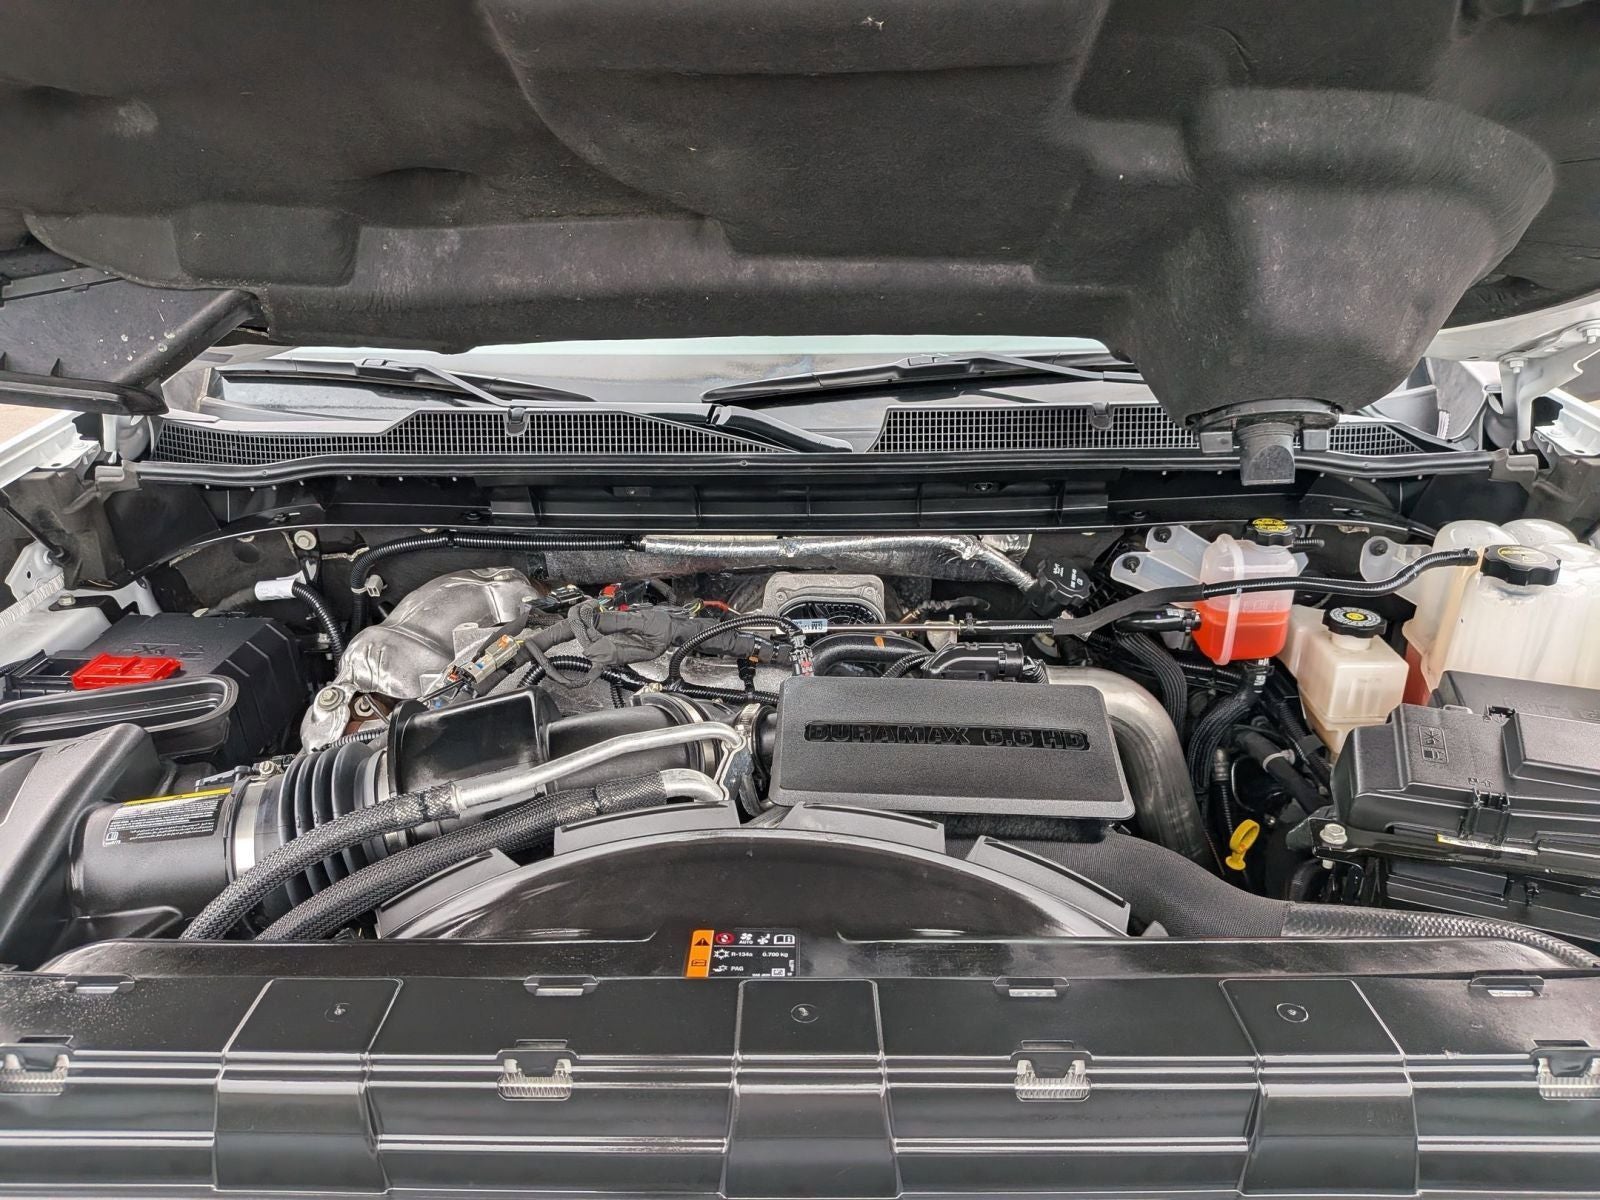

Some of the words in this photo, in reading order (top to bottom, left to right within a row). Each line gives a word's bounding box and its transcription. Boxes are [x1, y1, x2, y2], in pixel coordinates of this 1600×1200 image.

[809, 723, 971, 745] DURAMAX
[982, 727, 1034, 747] 6.6
[1040, 729, 1088, 750] HD
